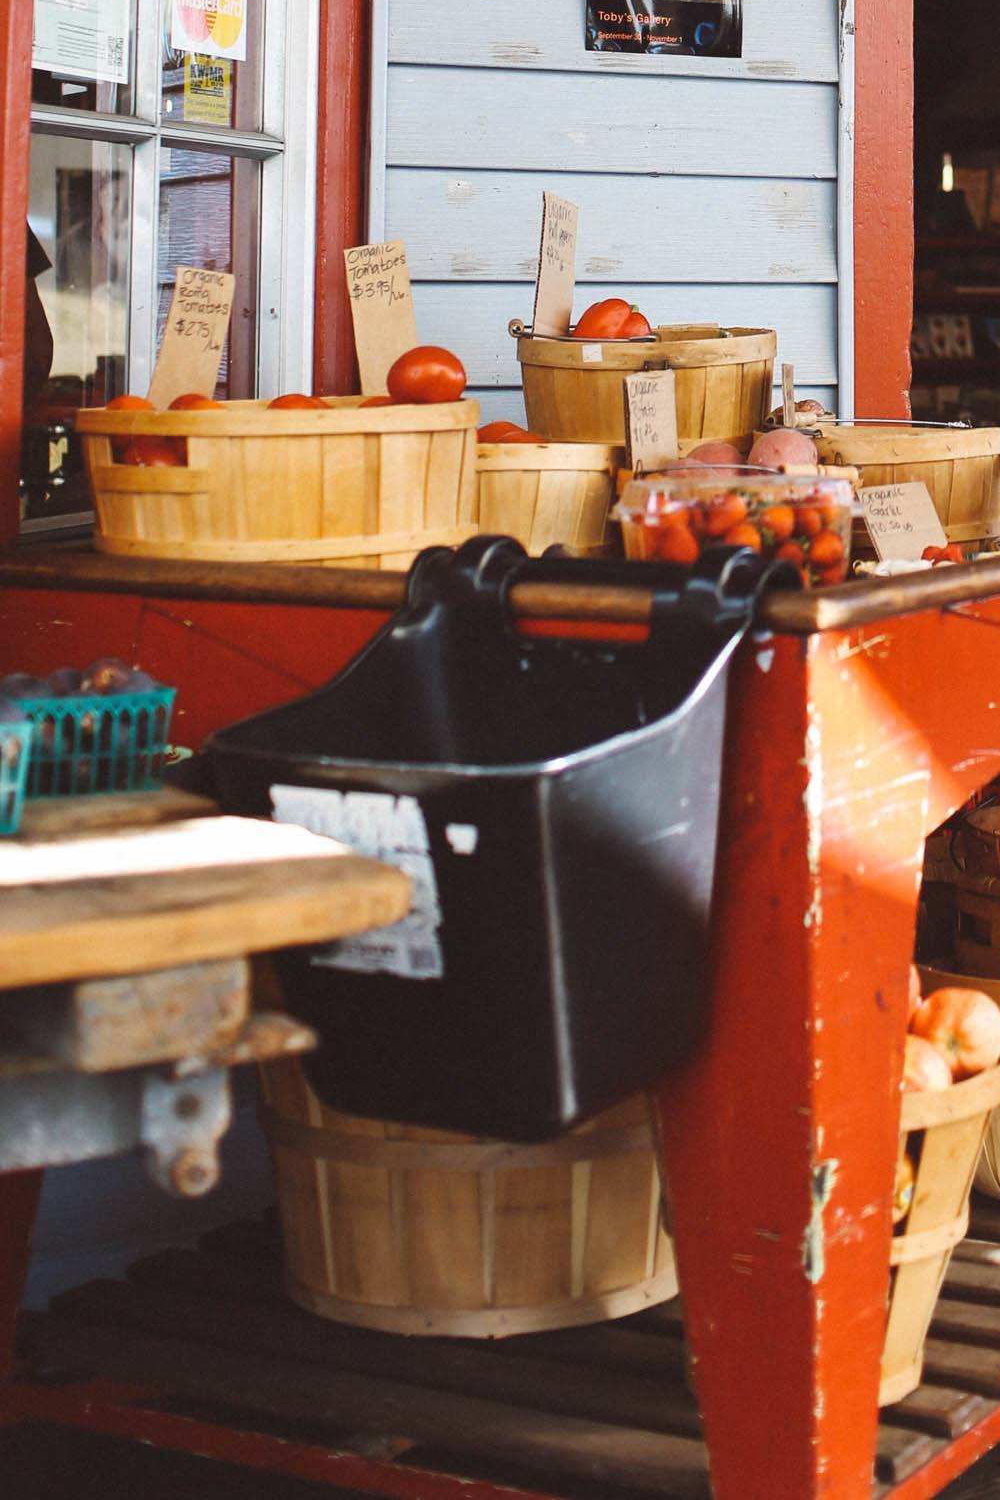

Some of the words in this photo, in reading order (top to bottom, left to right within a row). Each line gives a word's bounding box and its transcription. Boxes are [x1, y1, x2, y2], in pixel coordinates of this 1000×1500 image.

[598, 10, 633, 24] Toby's
[636, 12, 673, 27] Gallery
[598, 31, 632, 41] September
[647, 33, 677, 43] November
[347, 245, 396, 264] Organic
[349, 255, 406, 281] Tomatoes
[183, 269, 225, 287] Organic
[180, 286, 209, 303] Roma
[178, 299, 229, 315] Tomatoes
